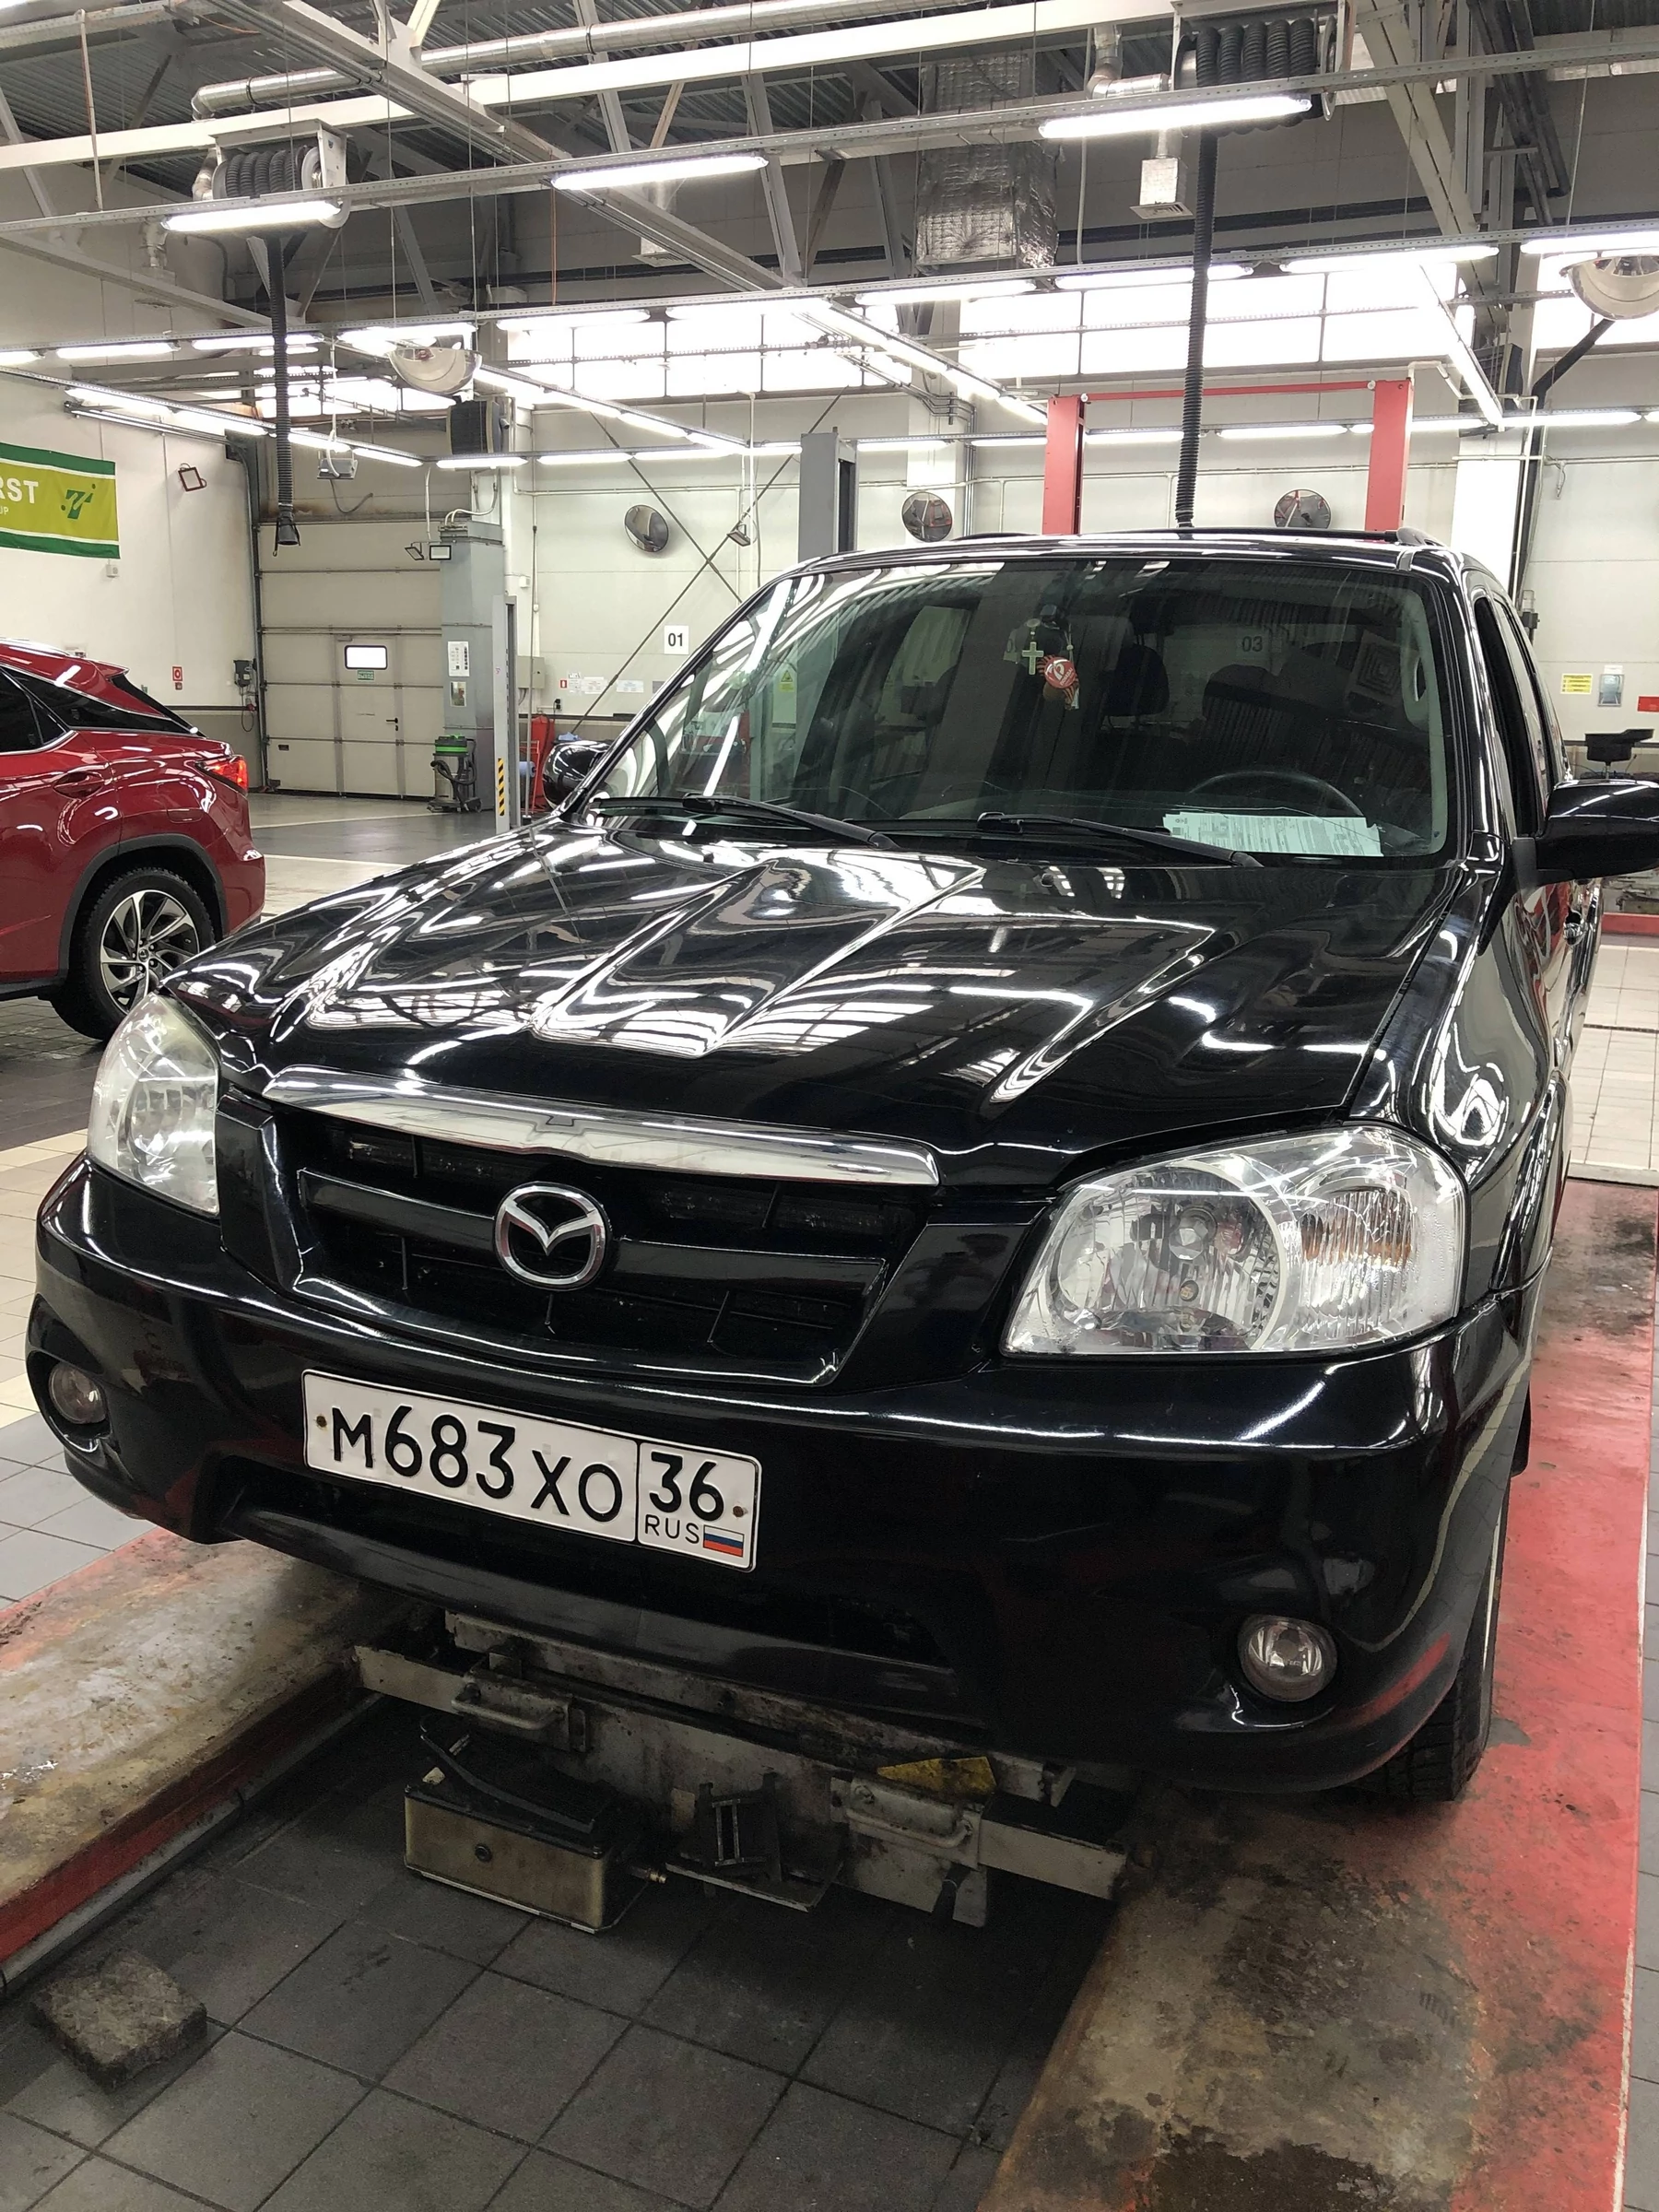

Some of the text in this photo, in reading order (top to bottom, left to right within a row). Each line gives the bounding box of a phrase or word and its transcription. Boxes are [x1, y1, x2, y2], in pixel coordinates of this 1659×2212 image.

[668, 632, 683, 647] 01
[1241, 635, 1264, 653] 03
[648, 1450, 725, 1523] 36
[643, 1513, 701, 1546] RUS
